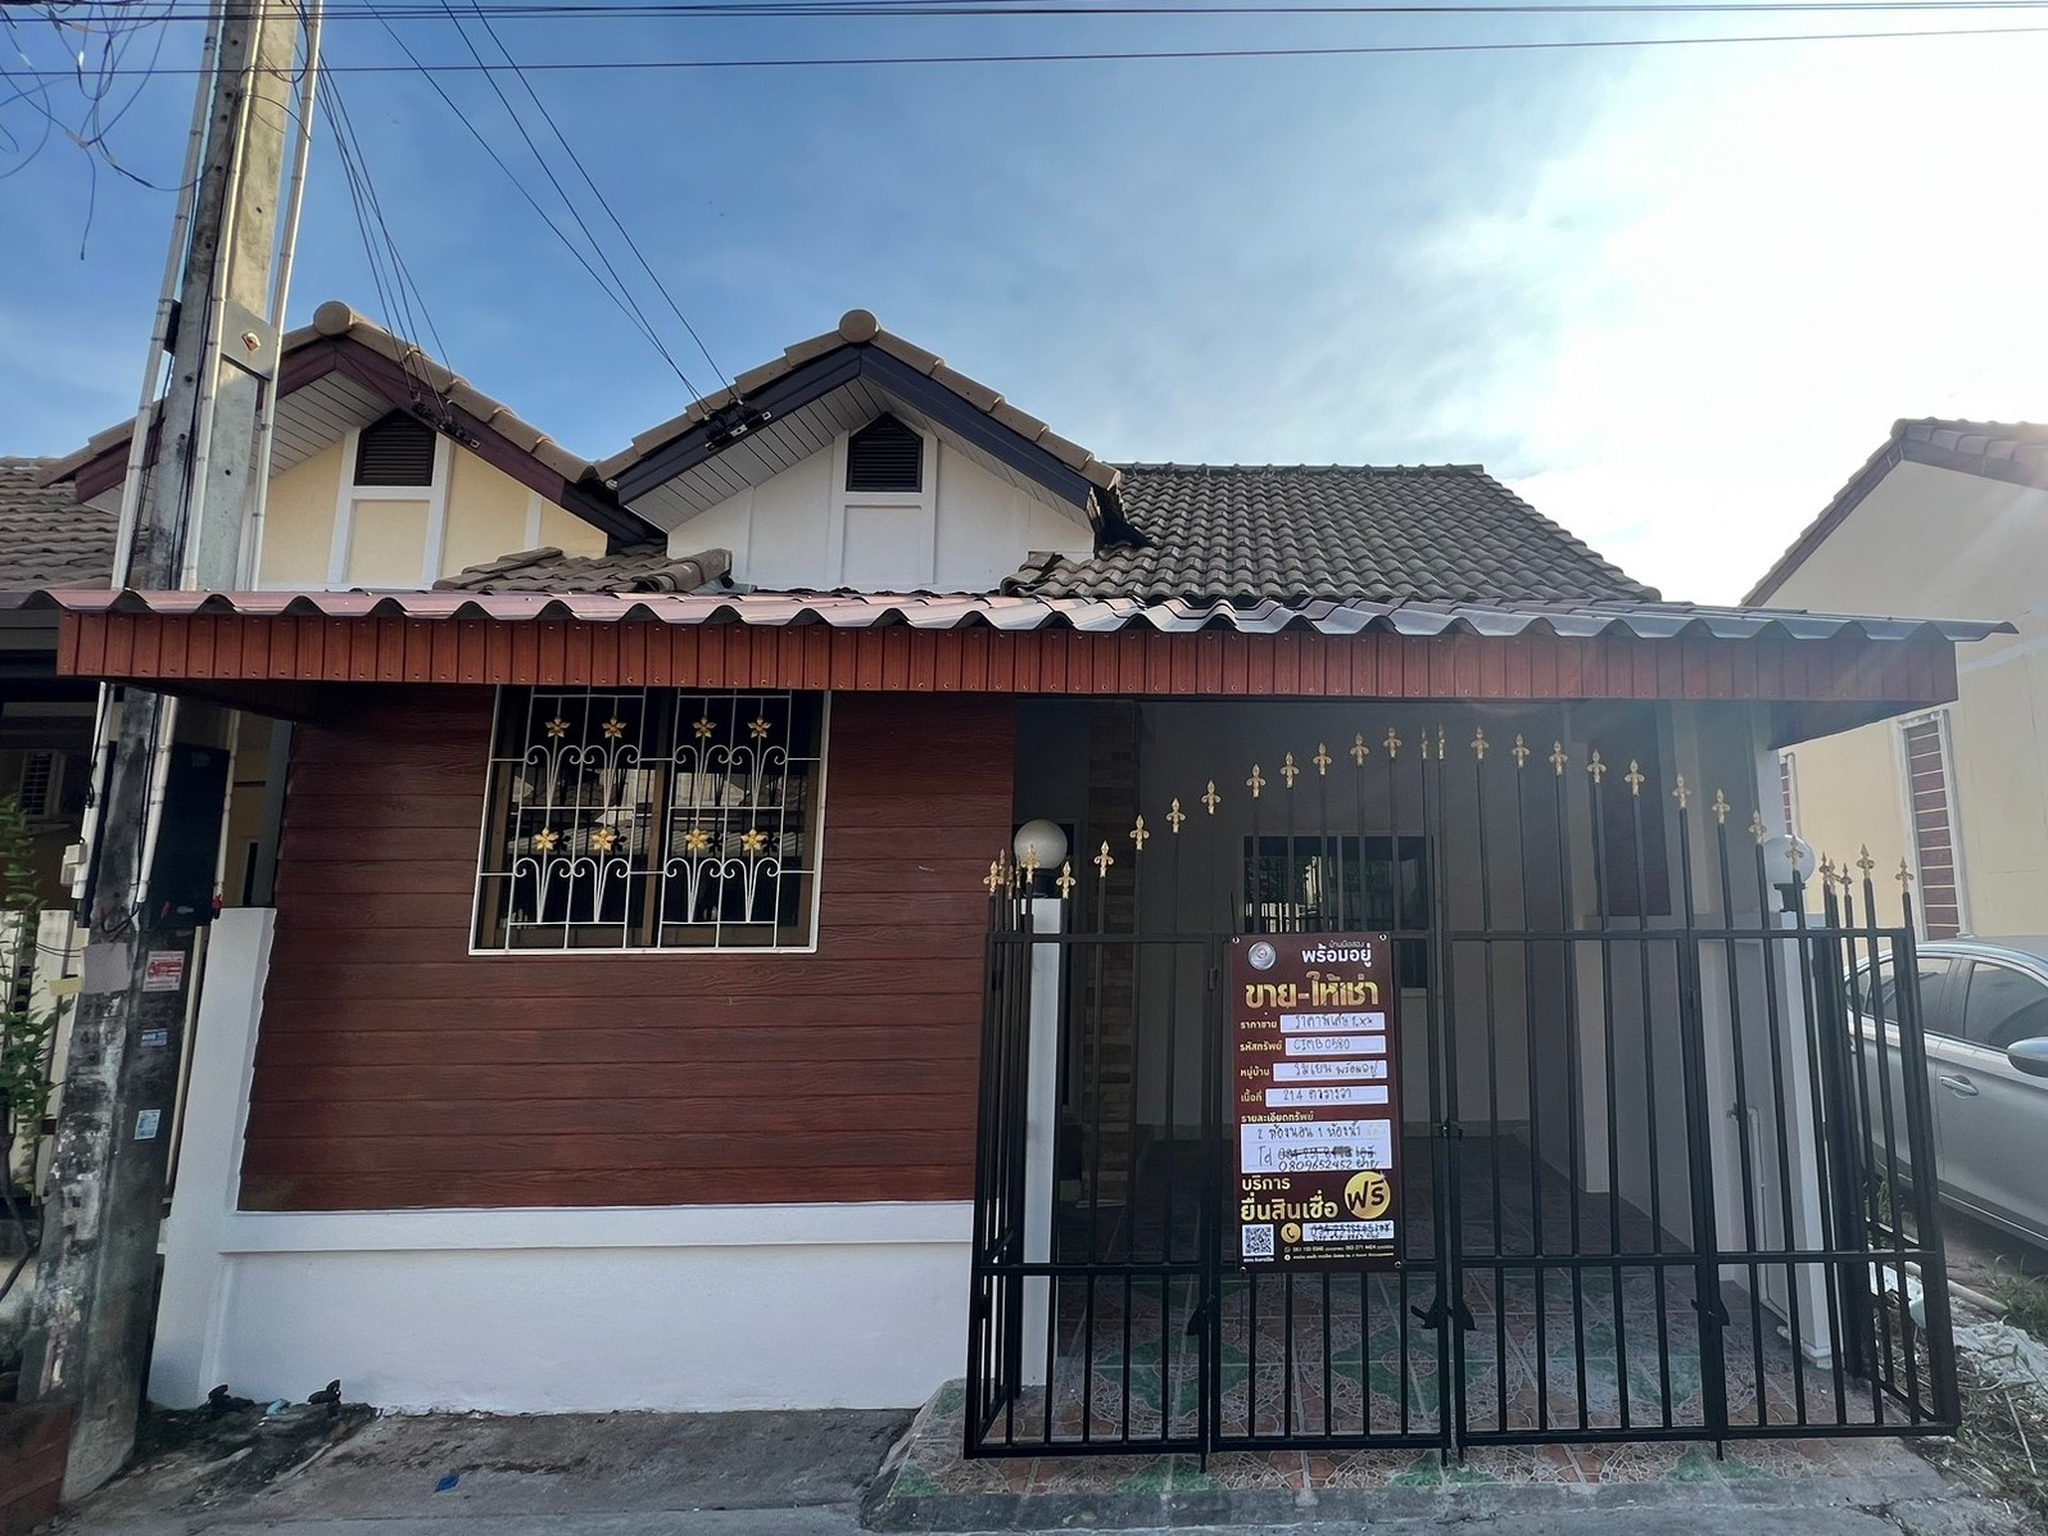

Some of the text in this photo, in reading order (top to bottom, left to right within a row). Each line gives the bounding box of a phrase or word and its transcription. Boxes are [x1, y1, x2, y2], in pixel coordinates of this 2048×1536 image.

[1302, 942, 1372, 968] พร้อมอยู่
[1245, 971, 1379, 1009] ขาย-ให้เช่า
[1240, 1019, 1277, 1029] ราคาขาย
[1239, 1040, 1282, 1052] รหัสทรัพย์
[1240, 1064, 1270, 1080] หมู่บ้าน
[1240, 1088, 1263, 1102] เนื้อที่
[1241, 1111, 1314, 1123] รายละเอียดทรัพย์
[1241, 1175, 1292, 1191] บริการ
[1347, 1179, 1385, 1211] ฟรี
[1240, 1190, 1339, 1221] ยื่นสินเชื่อ
